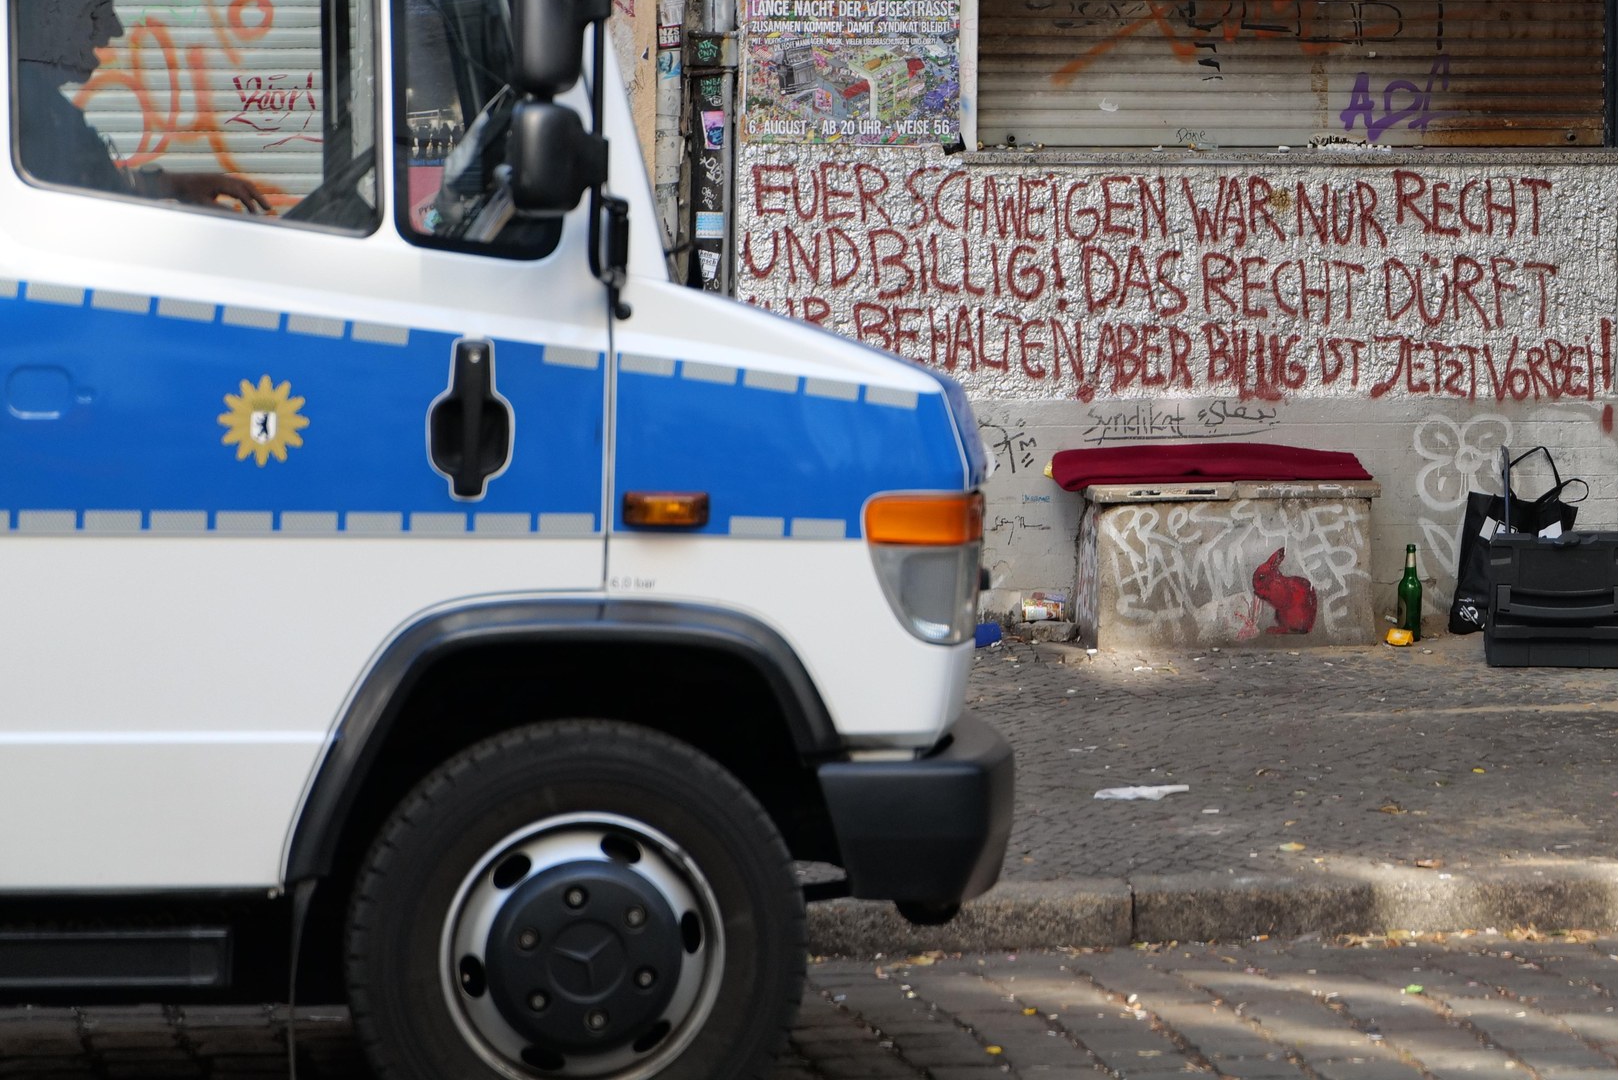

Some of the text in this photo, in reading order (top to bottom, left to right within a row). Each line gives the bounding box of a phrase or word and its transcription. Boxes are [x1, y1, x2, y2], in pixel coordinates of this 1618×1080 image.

[752, 0, 955, 16] LANGE NACHT DER WEISESTRASSE
[752, 22, 800, 33] ZUSAMMEN
[848, 22, 874, 33] DAMIT
[878, 22, 917, 33] SYNDIKAT
[922, 22, 950, 33] BLEIBT!
[764, 121, 806, 135] AUGUST
[822, 121, 836, 135] AB
[841, 121, 854, 135] 20
[859, 121, 881, 135] UHR
[897, 121, 929, 135] WEISE
[934, 121, 949, 135] 56
[752, 163, 892, 225] EUER
[905, 166, 1167, 243] SCHWEIGEN
[1182, 175, 1286, 248] WAR
[1298, 181, 1387, 248] NUR
[1393, 170, 1552, 237] RECHT
[744, 225, 860, 288] UND
[1082, 244, 1188, 319] DAS
[1202, 252, 1365, 321] RECHT
[1384, 252, 1557, 330] DÜRFT
[1100, 321, 1192, 393] ABER
[1318, 338, 1366, 387] IST
